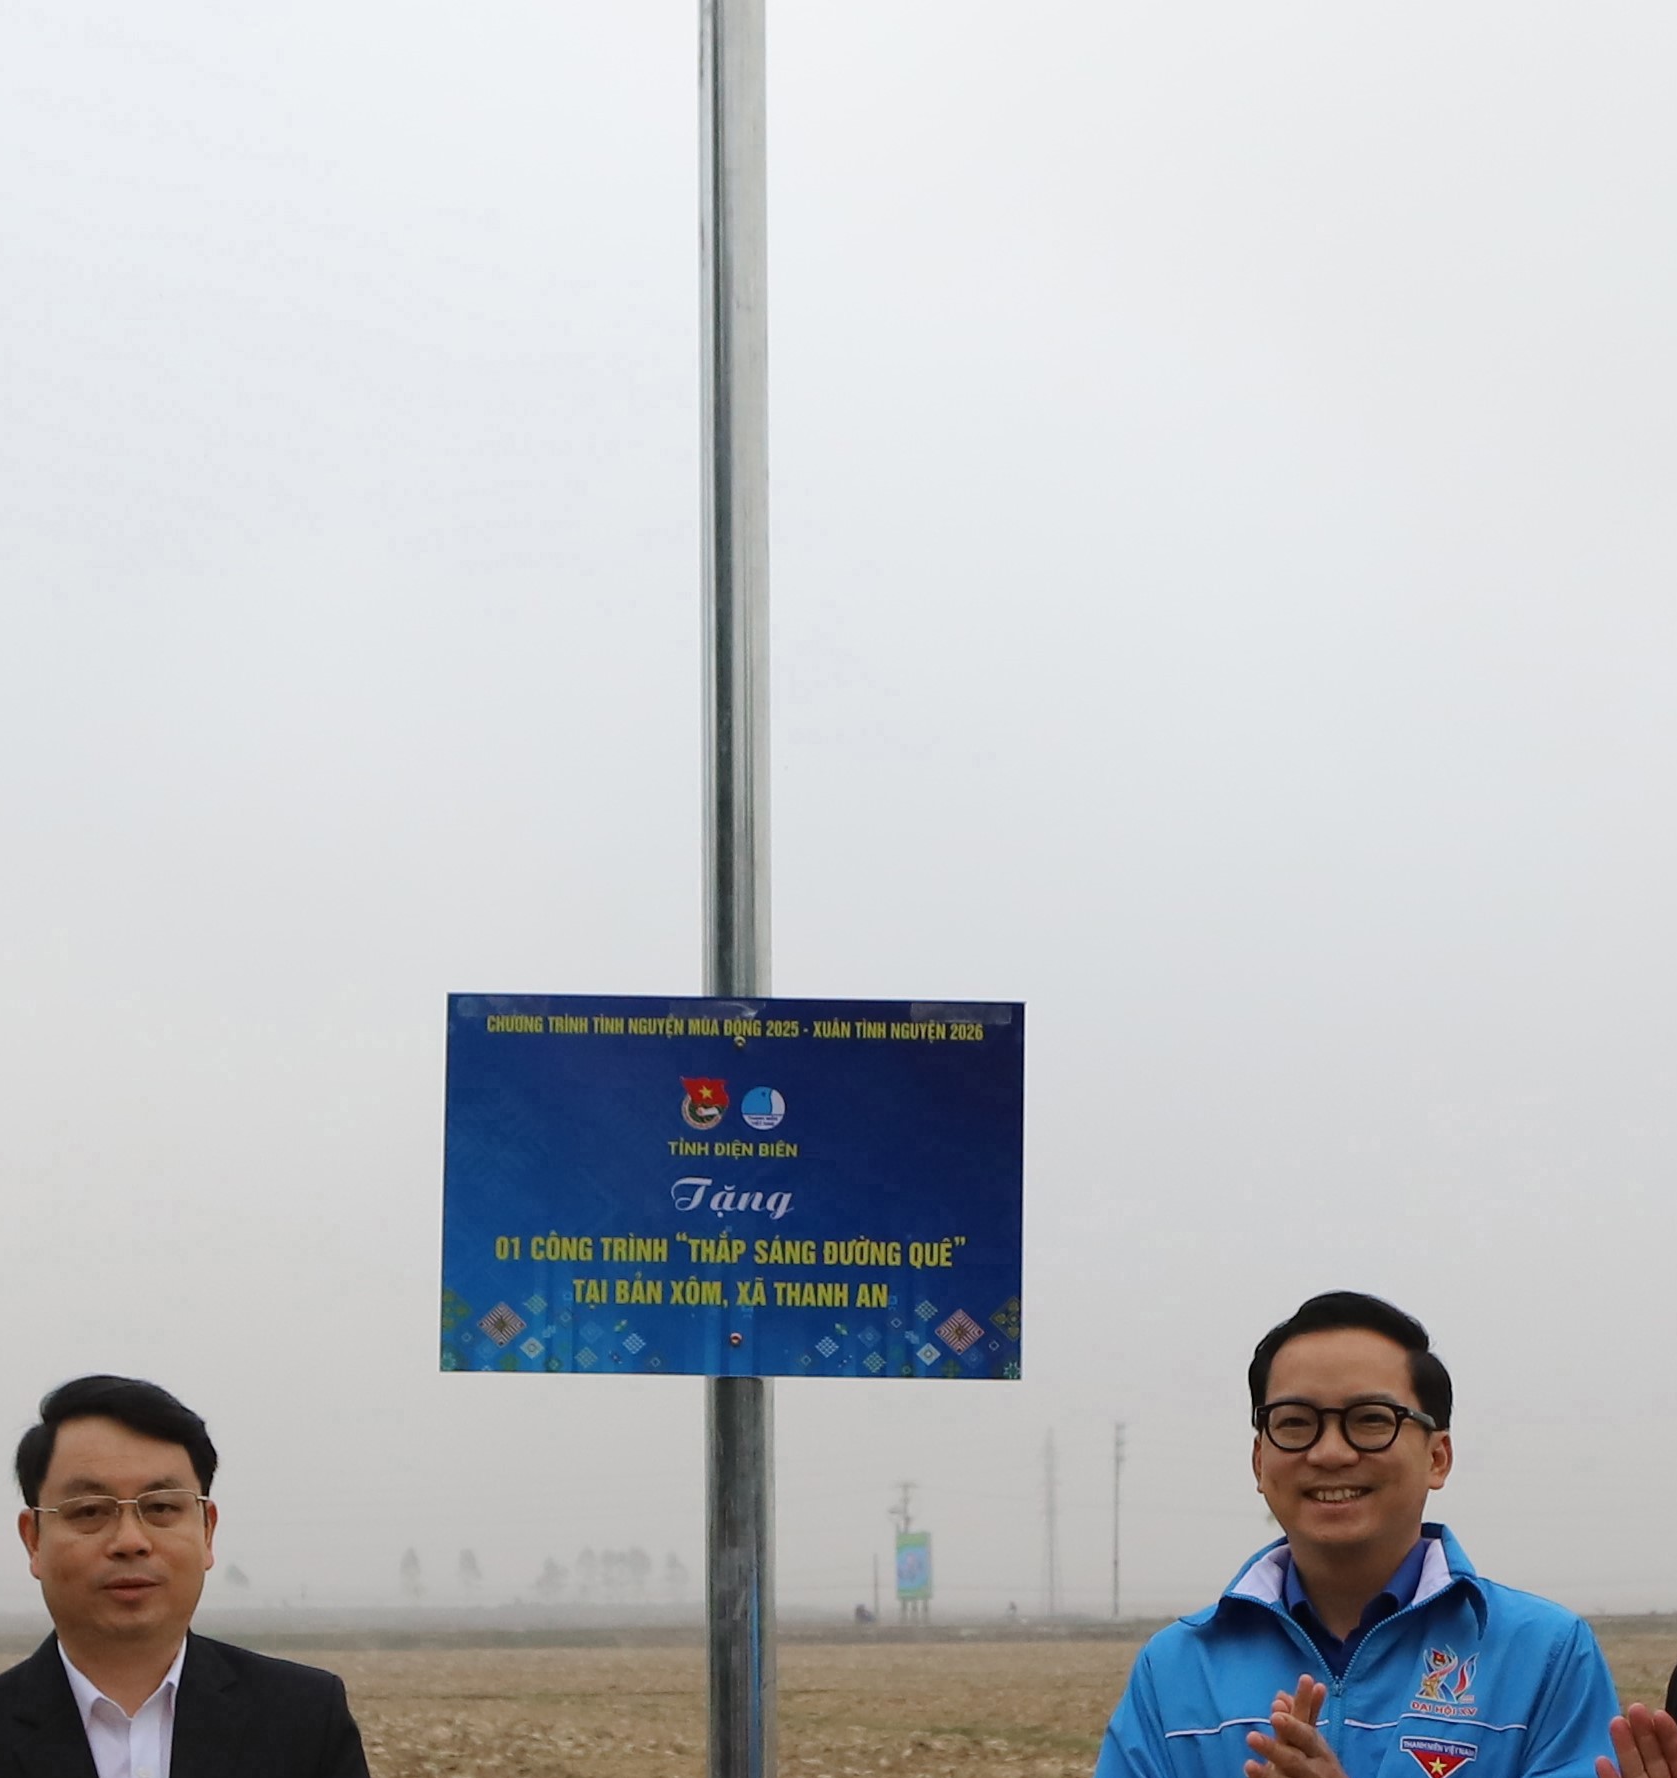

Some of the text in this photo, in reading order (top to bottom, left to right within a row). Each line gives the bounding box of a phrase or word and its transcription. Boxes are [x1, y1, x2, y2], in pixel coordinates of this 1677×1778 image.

[548, 1013, 589, 1035] TRÌNH
[592, 1013, 625, 1035] TÌNH
[628, 1013, 685, 1039] NGUYỆN
[688, 1015, 720, 1036] MÙA
[765, 1020, 800, 1038] 2025
[812, 1016, 851, 1039] XUÂN
[854, 1017, 886, 1040] TÌNH
[890, 1018, 946, 1044] NGUYỆN
[950, 1022, 984, 1041] 2026
[713, 1138, 754, 1160] ĐIỆN
[758, 1139, 798, 1158] BIÊN
[670, 1176, 795, 1220] Tặng
[494, 1235, 521, 1261] 01
[530, 1229, 594, 1262] CÔNG
[599, 1232, 669, 1263] TRÌNH
[753, 1234, 818, 1266] SÁNG
[822, 1235, 902, 1267] ĐƯỜNG
[573, 1278, 609, 1310] TẠI
[614, 1270, 663, 1305] BẢN
[735, 1275, 767, 1307] XÃ
[773, 1280, 849, 1308] THANH
[854, 1282, 889, 1308] AN
